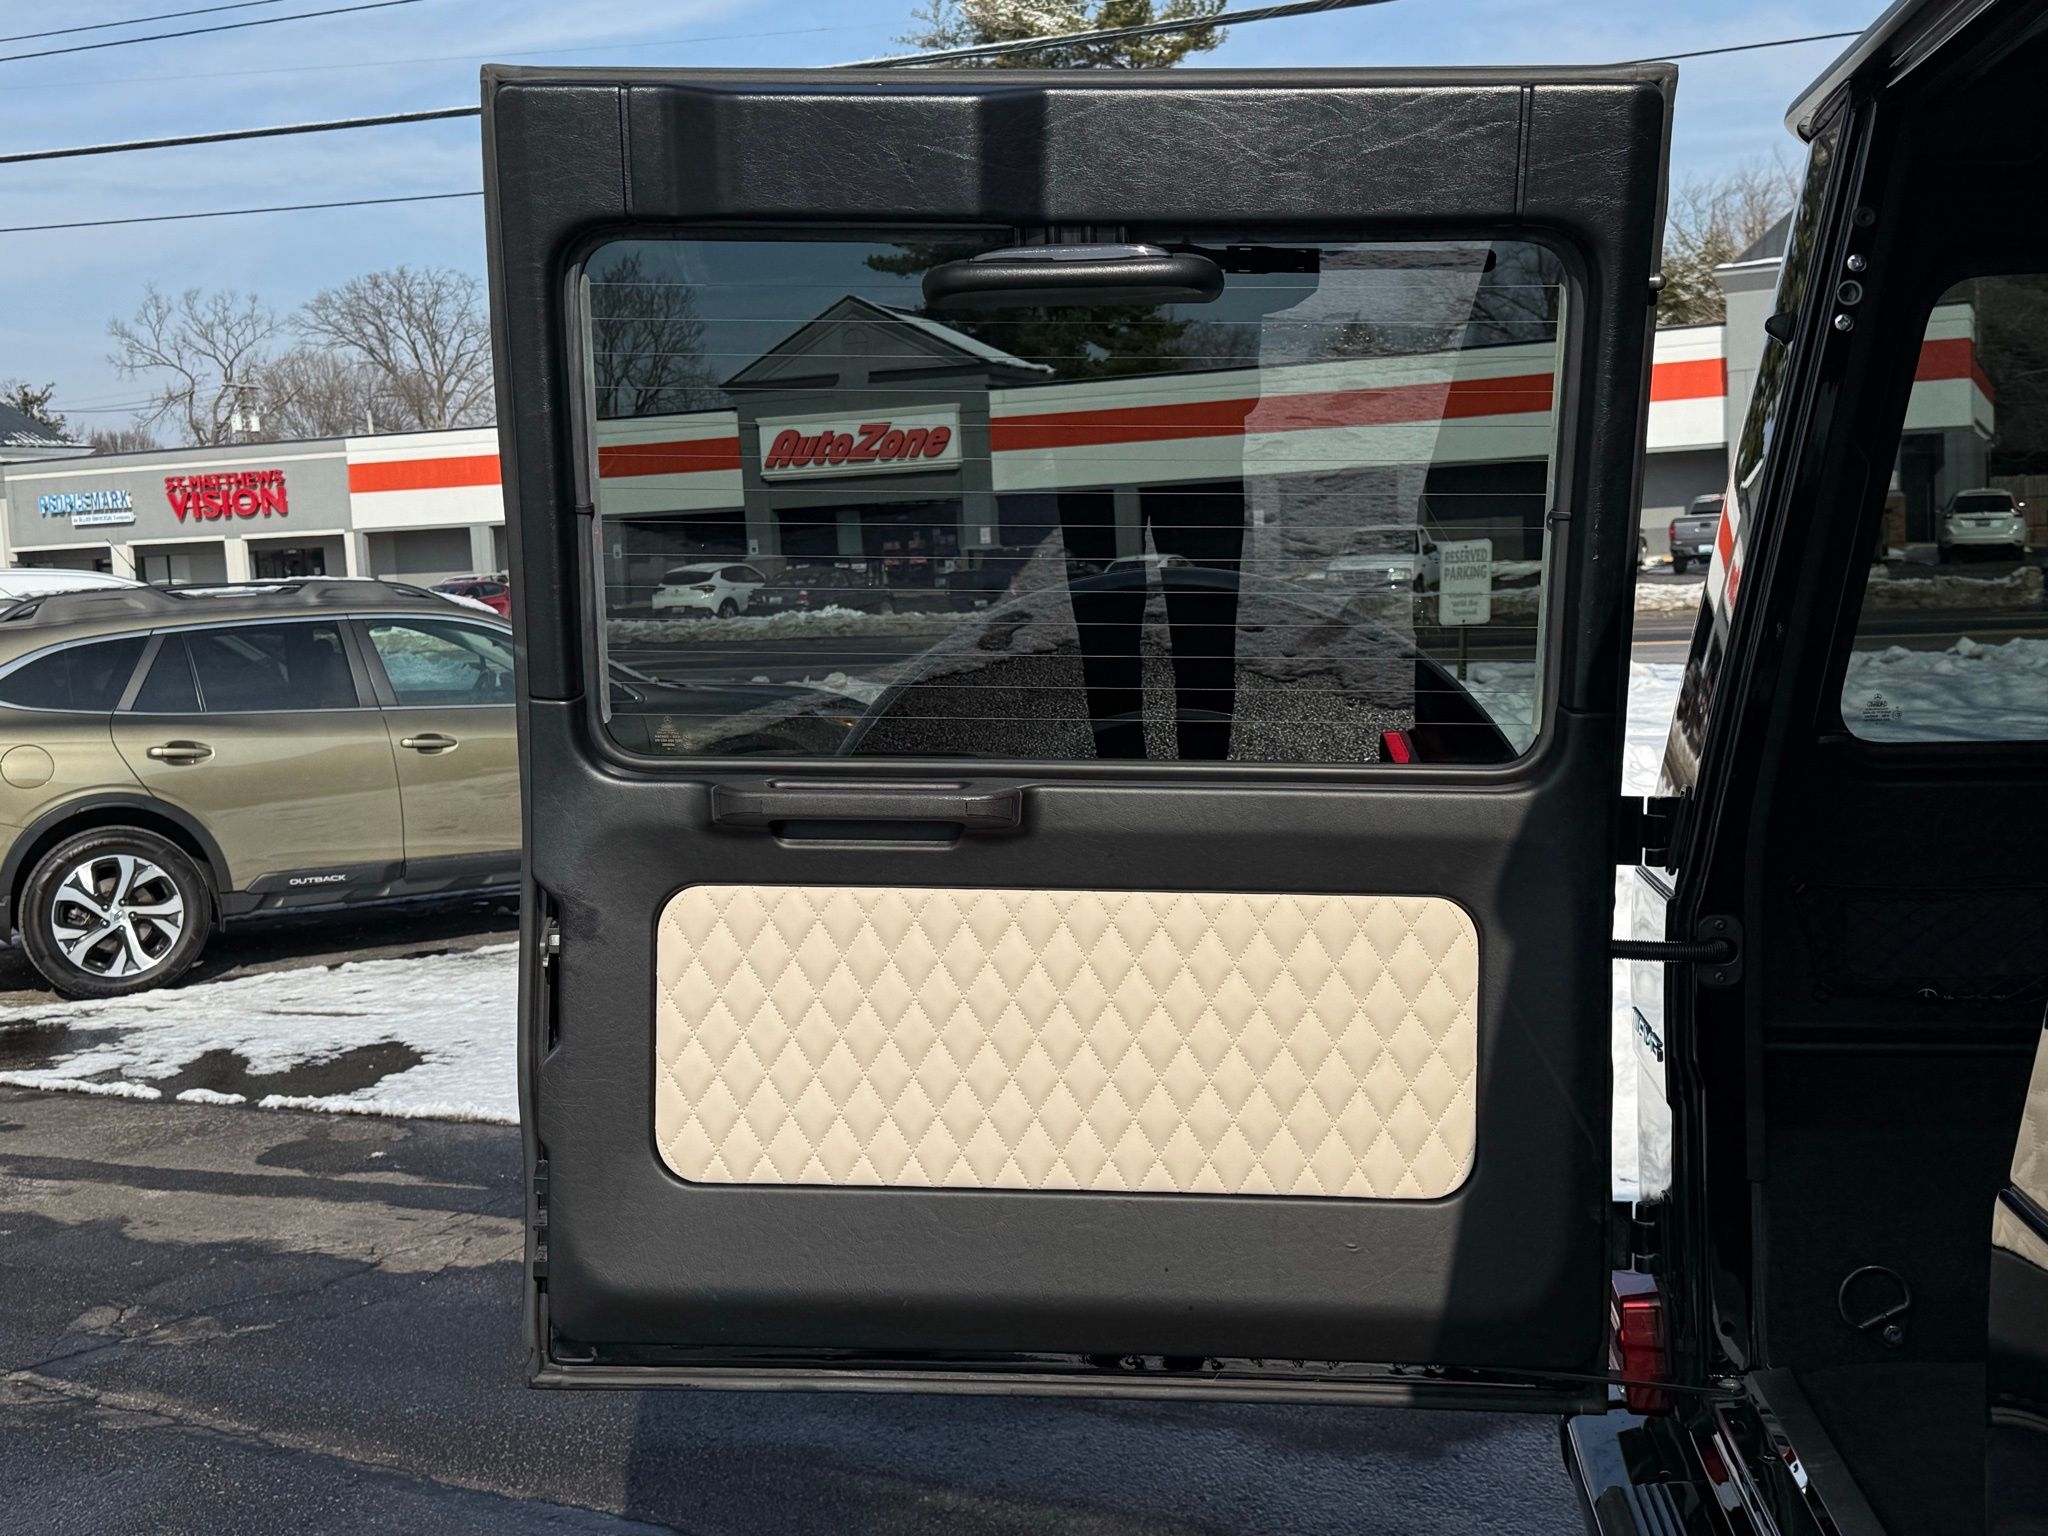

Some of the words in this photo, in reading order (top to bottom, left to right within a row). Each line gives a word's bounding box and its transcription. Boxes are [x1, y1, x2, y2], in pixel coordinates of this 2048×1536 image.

[764, 421, 952, 470] AutoZone
[188, 470, 285, 488] MATTHEWS
[167, 487, 288, 520] VISION
[1445, 549, 1488, 563] RESERVED
[1444, 565, 1488, 581] PARKING
[289, 874, 346, 886] OUTBACK
